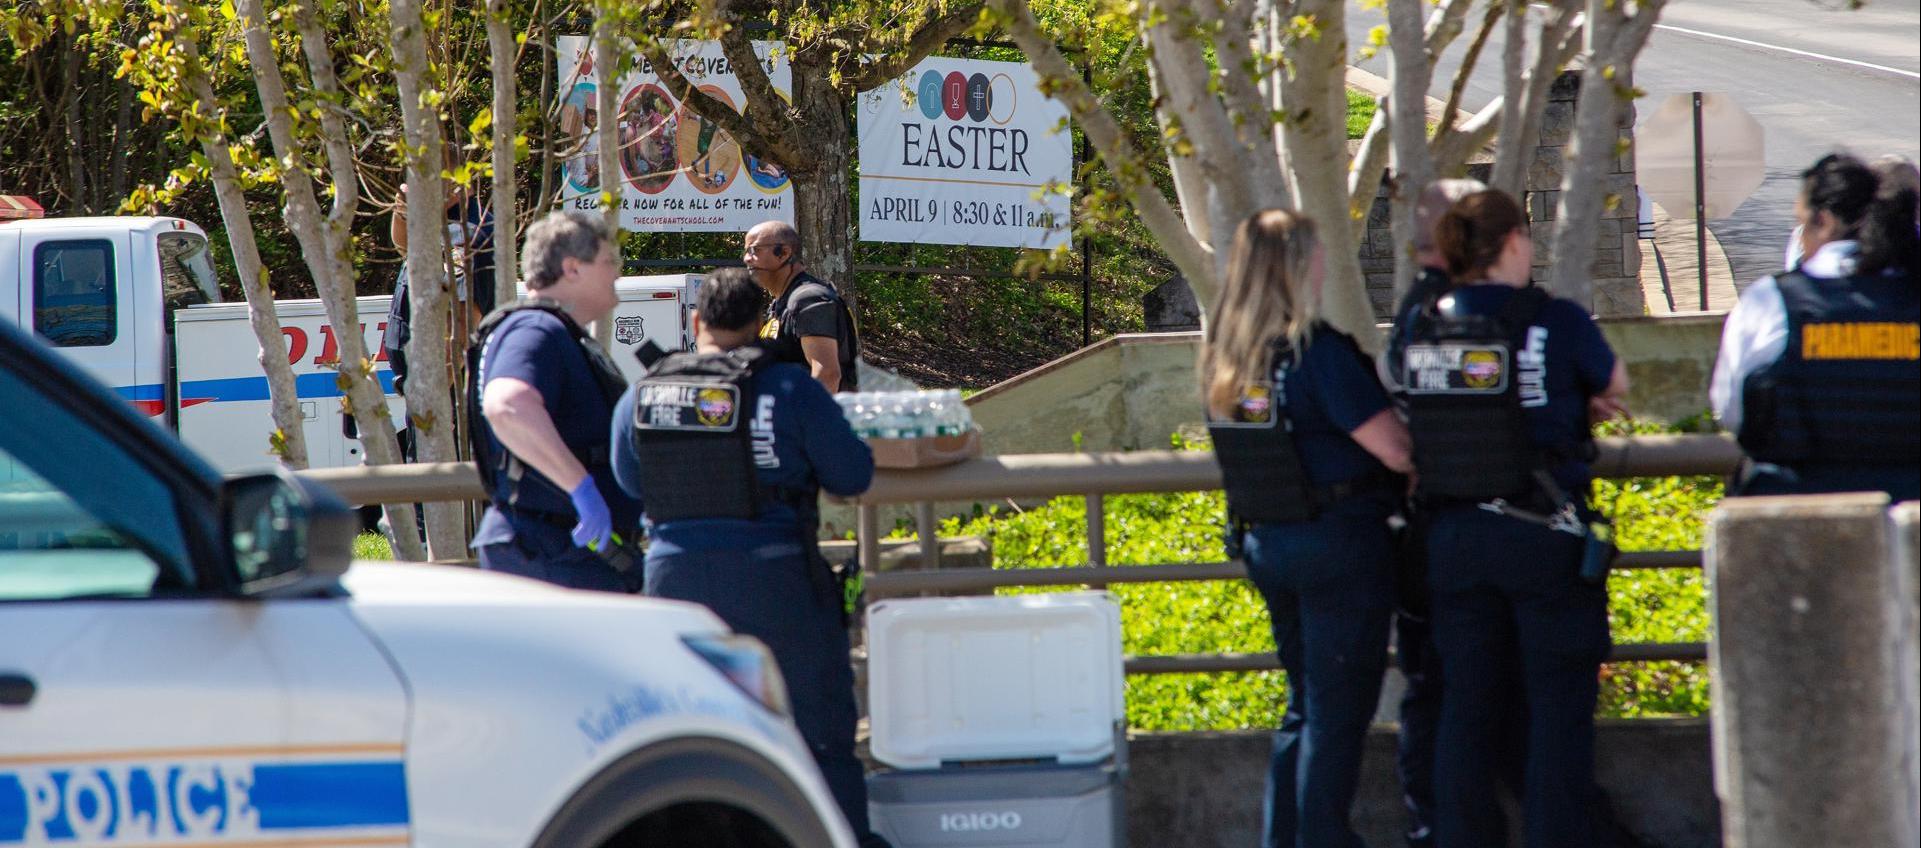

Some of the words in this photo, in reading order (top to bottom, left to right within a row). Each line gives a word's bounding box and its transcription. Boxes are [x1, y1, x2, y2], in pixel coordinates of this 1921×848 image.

[901, 122, 1031, 176] EASTER
[634, 198, 658, 210] NOW
[664, 198, 685, 210] FOR
[689, 198, 709, 210] ALL
[715, 198, 729, 210] OF
[734, 198, 752, 210] THE
[757, 196, 782, 210] FUN!
[870, 197, 925, 223] APRIL
[928, 199, 938, 223] 9
[953, 200, 989, 225] 8:30
[993, 202, 1007, 225] &
[633, 216, 724, 225] THECOVENANTSCHOOL.COM
[22, 764, 259, 843] POLICE
